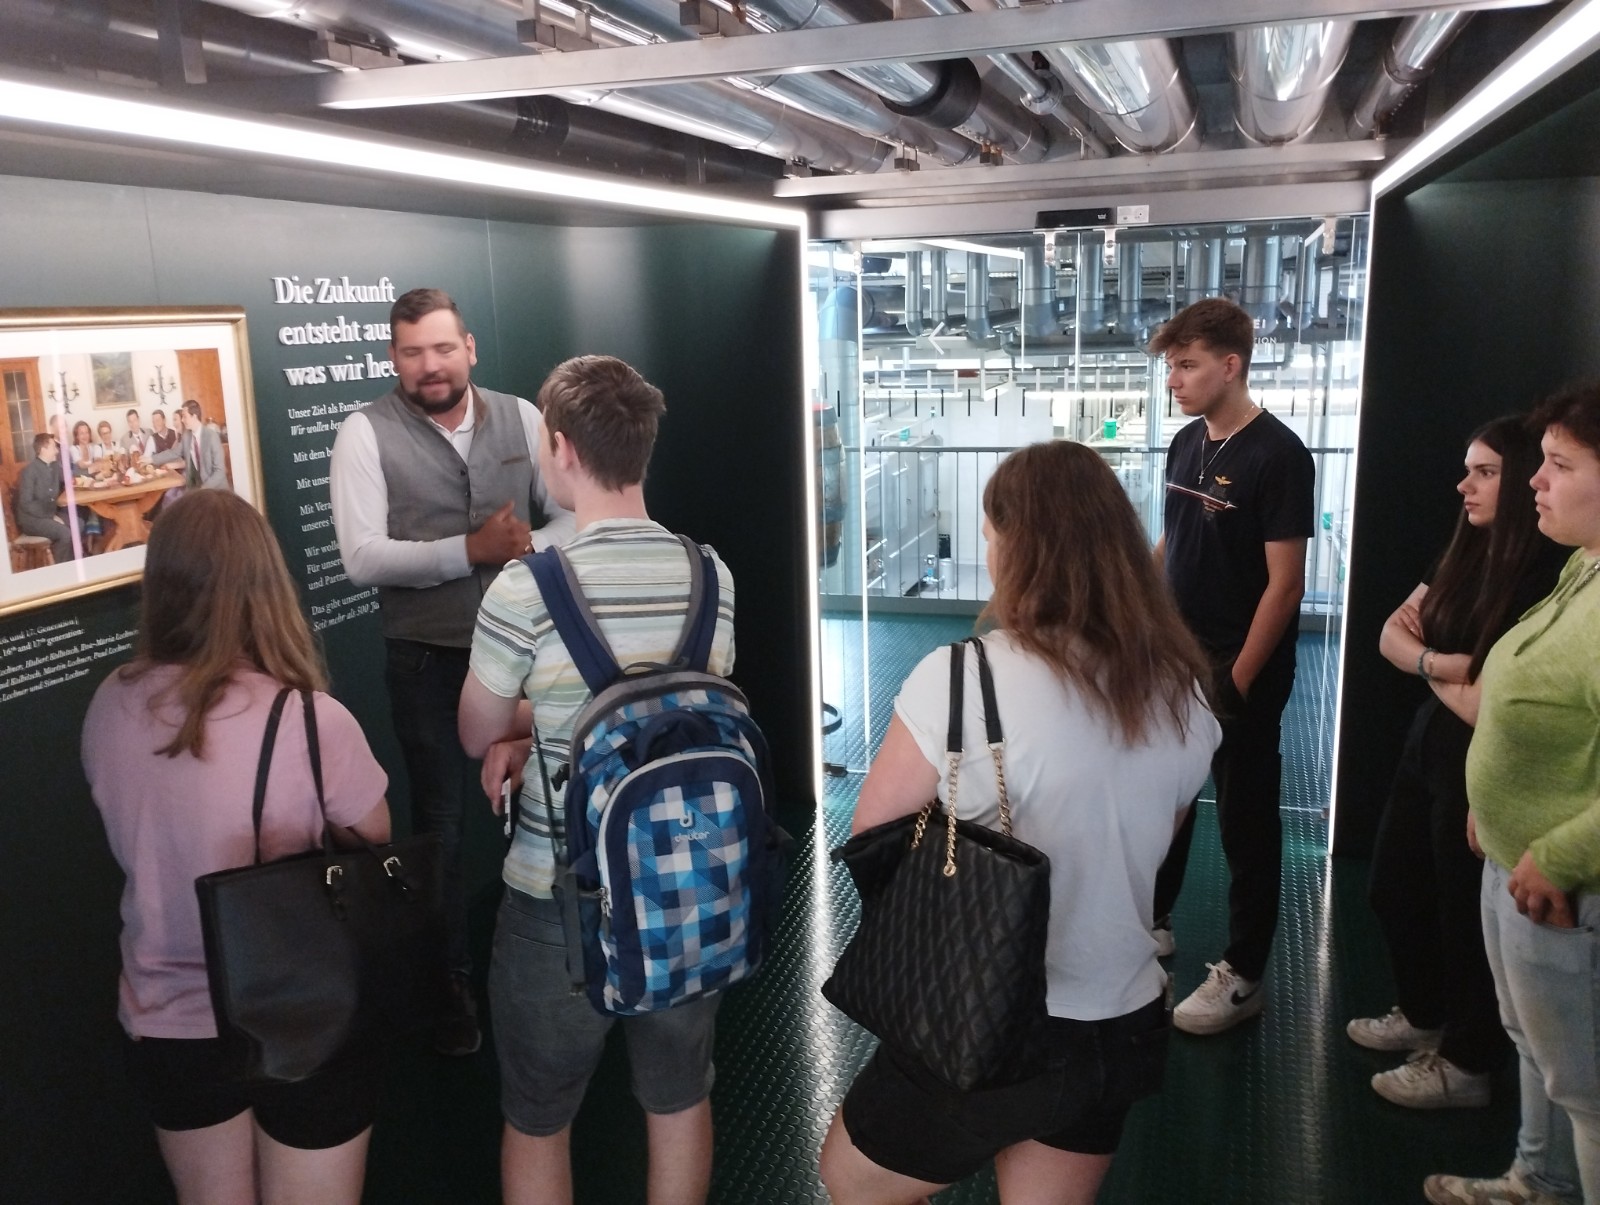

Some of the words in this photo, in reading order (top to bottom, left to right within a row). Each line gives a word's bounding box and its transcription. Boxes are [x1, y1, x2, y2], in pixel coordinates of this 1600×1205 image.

[272, 275, 314, 304] Die
[314, 276, 397, 304] Zukunft
[279, 315, 362, 345] entsteht
[283, 365, 327, 386] was
[327, 355, 365, 382] wir
[288, 408, 311, 419] Unser
[311, 404, 327, 416] Ziel
[328, 403, 338, 414] als
[290, 424, 306, 436] Wir
[306, 421, 329, 434] wollen
[293, 451, 308, 463] Mit
[308, 449, 326, 460] dem
[296, 478, 312, 490] Mit
[300, 504, 315, 516] Mit
[301, 519, 330, 532] unseres
[304, 545, 320, 557] Wir
[306, 563, 321, 575] Für
[308, 577, 324, 591] und
[311, 605, 325, 616] Das
[325, 598, 341, 614] gibt
[341, 590, 371, 605] unserem
[18, 641, 32, 652] and
[674, 831, 710, 843] deuter
